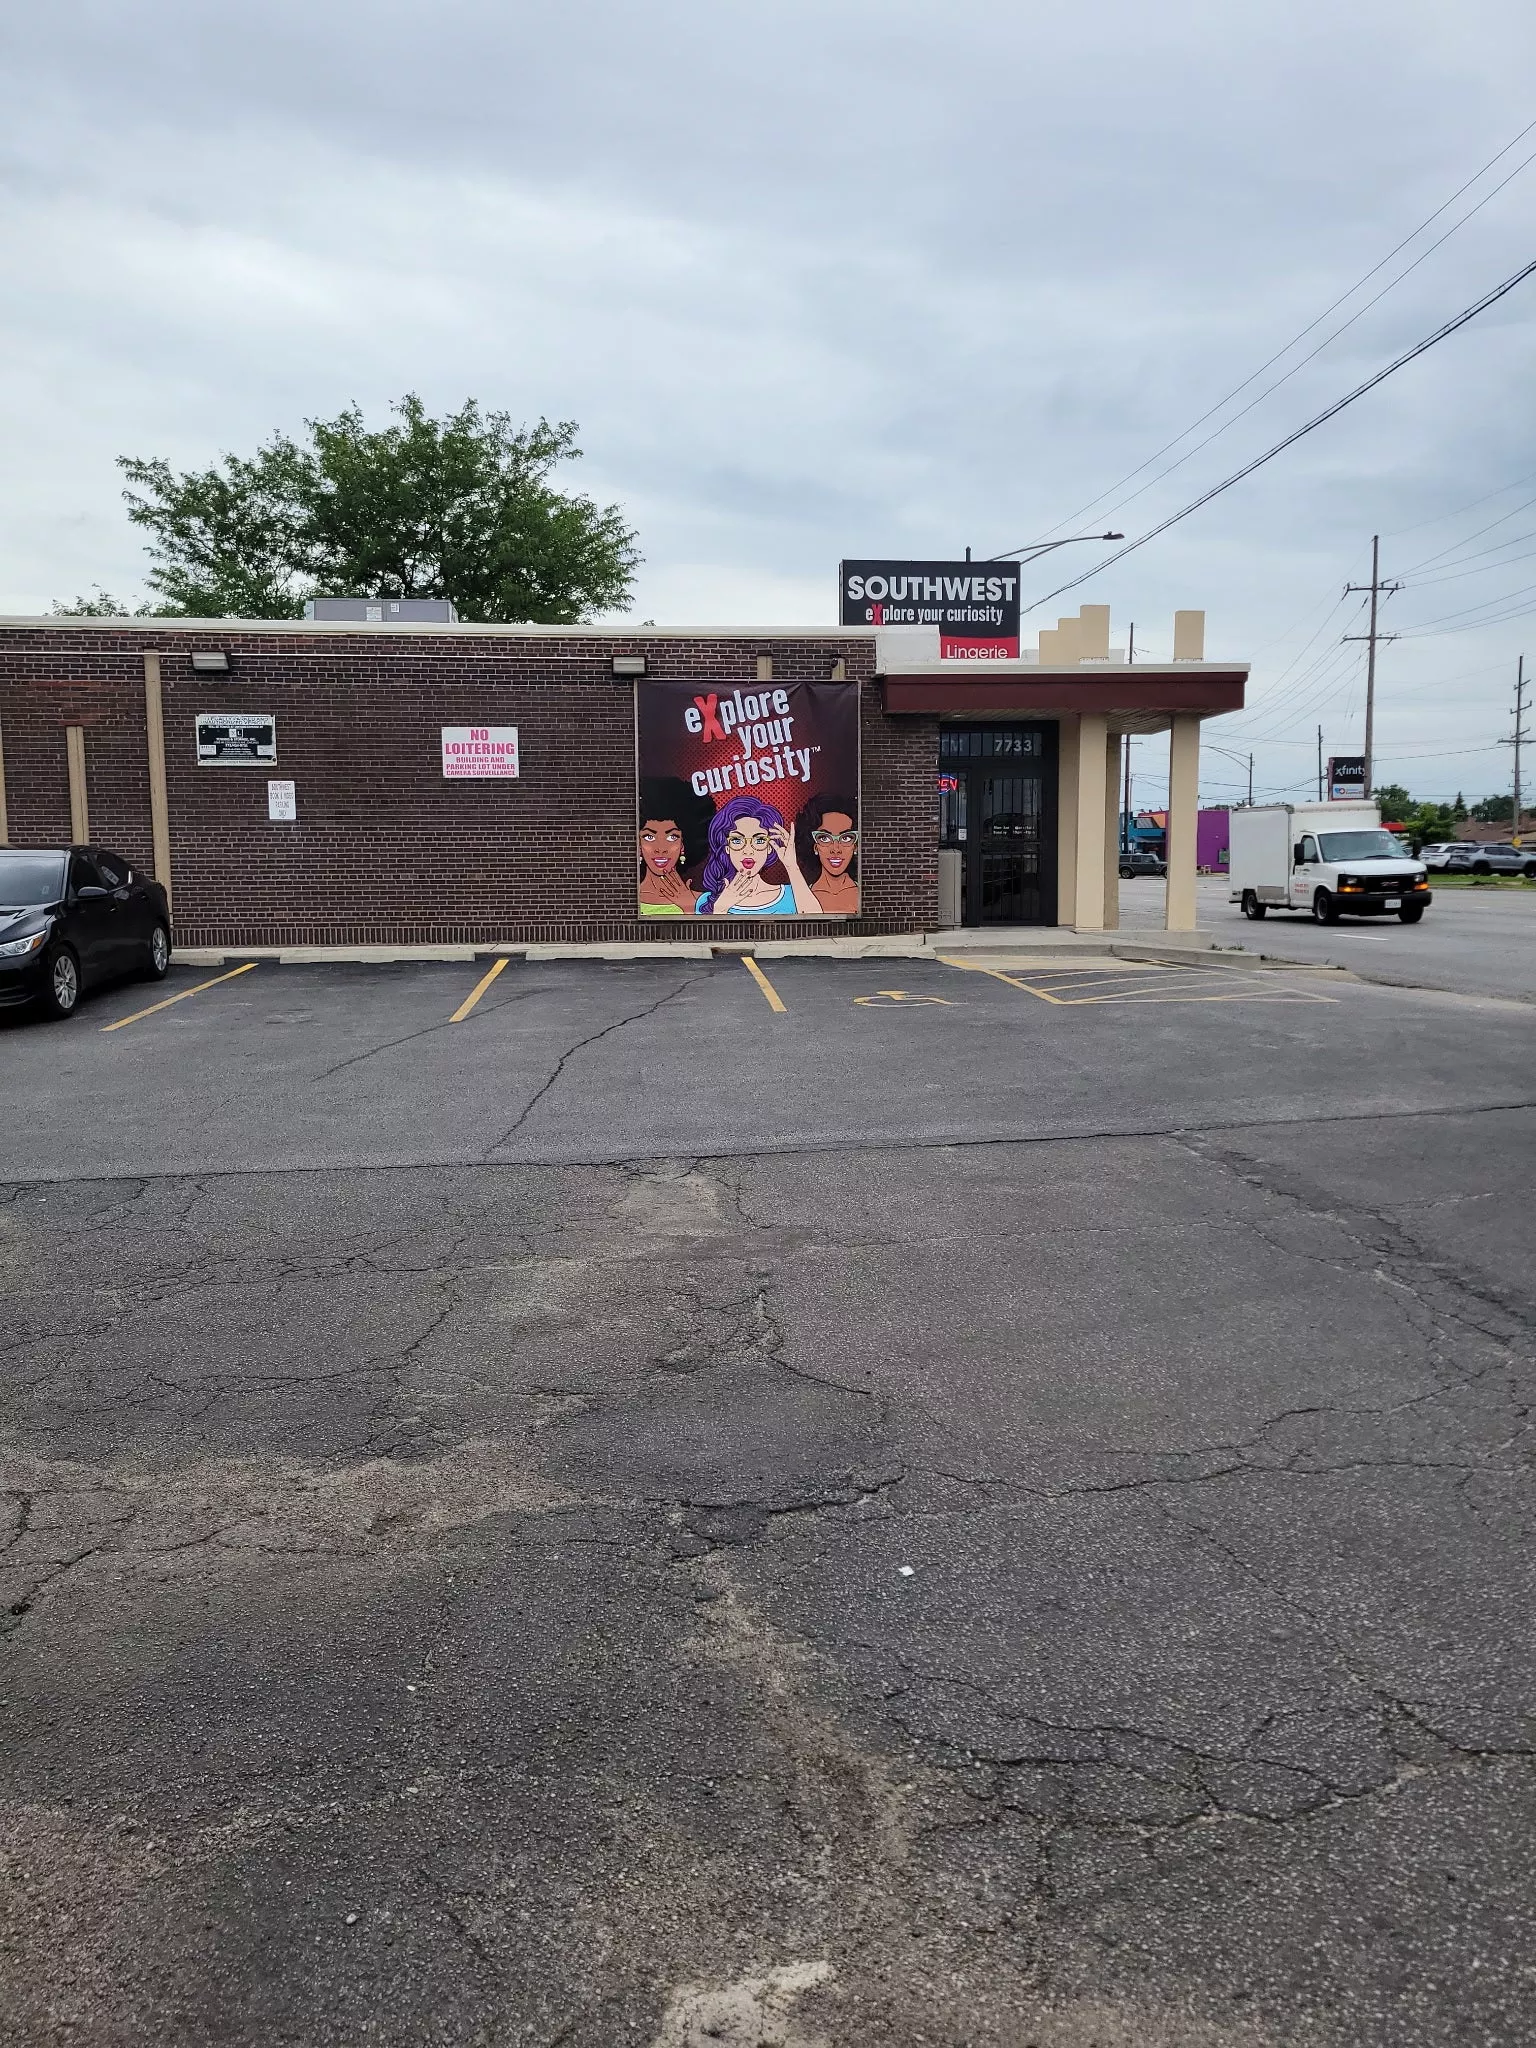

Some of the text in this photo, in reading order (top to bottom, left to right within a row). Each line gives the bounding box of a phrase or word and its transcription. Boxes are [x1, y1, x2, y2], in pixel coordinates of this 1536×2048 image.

[848, 575, 1016, 601] SOUTHWEST
[865, 603, 1003, 625] eXplore your curiosity
[946, 645, 1008, 659] Lingerie
[684, 689, 789, 743] eXplore
[470, 729, 489, 741] NO
[738, 716, 794, 760] your
[445, 743, 515, 755] LOITERING
[994, 739, 1033, 752] 7733
